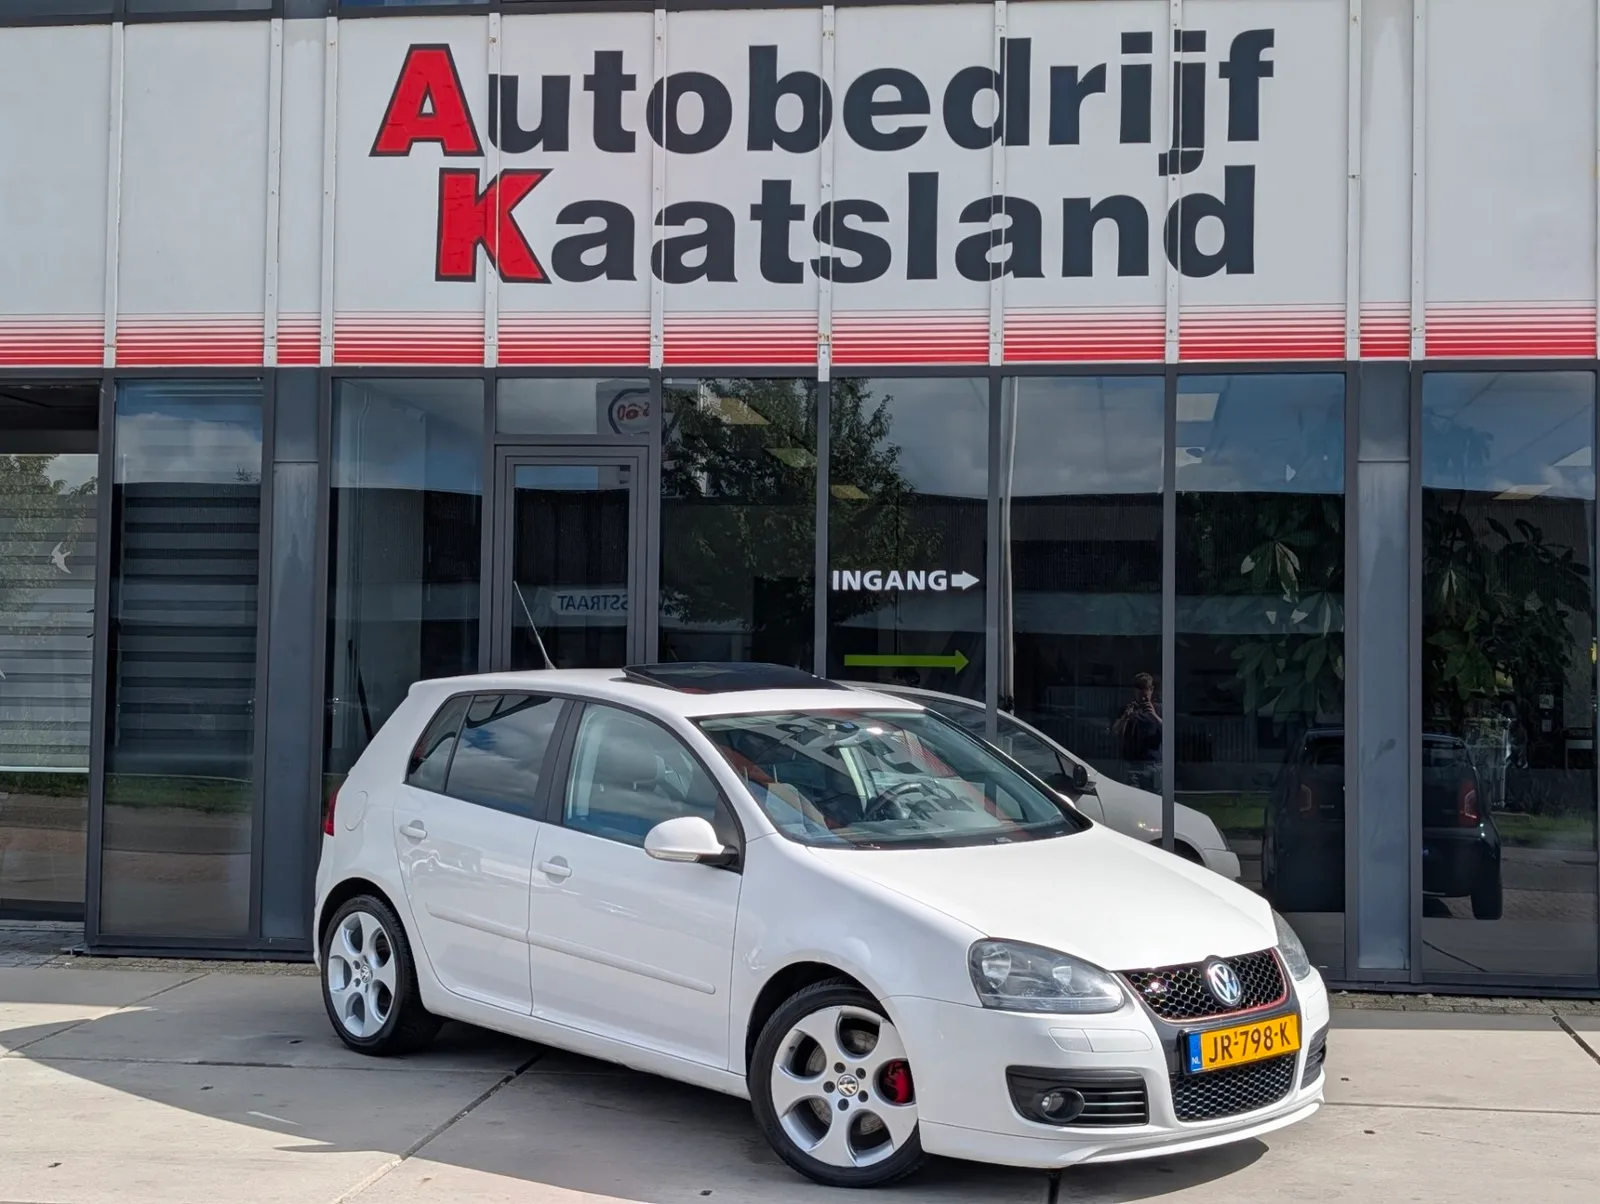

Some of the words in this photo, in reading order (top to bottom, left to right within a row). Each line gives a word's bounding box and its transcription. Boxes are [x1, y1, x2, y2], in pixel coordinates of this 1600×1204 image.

[369, 29, 1275, 176] Autobedrijf
[435, 165, 1255, 284] Kaatsland
[832, 570, 947, 591] INGANG
[1192, 1056, 1200, 1065] NL
